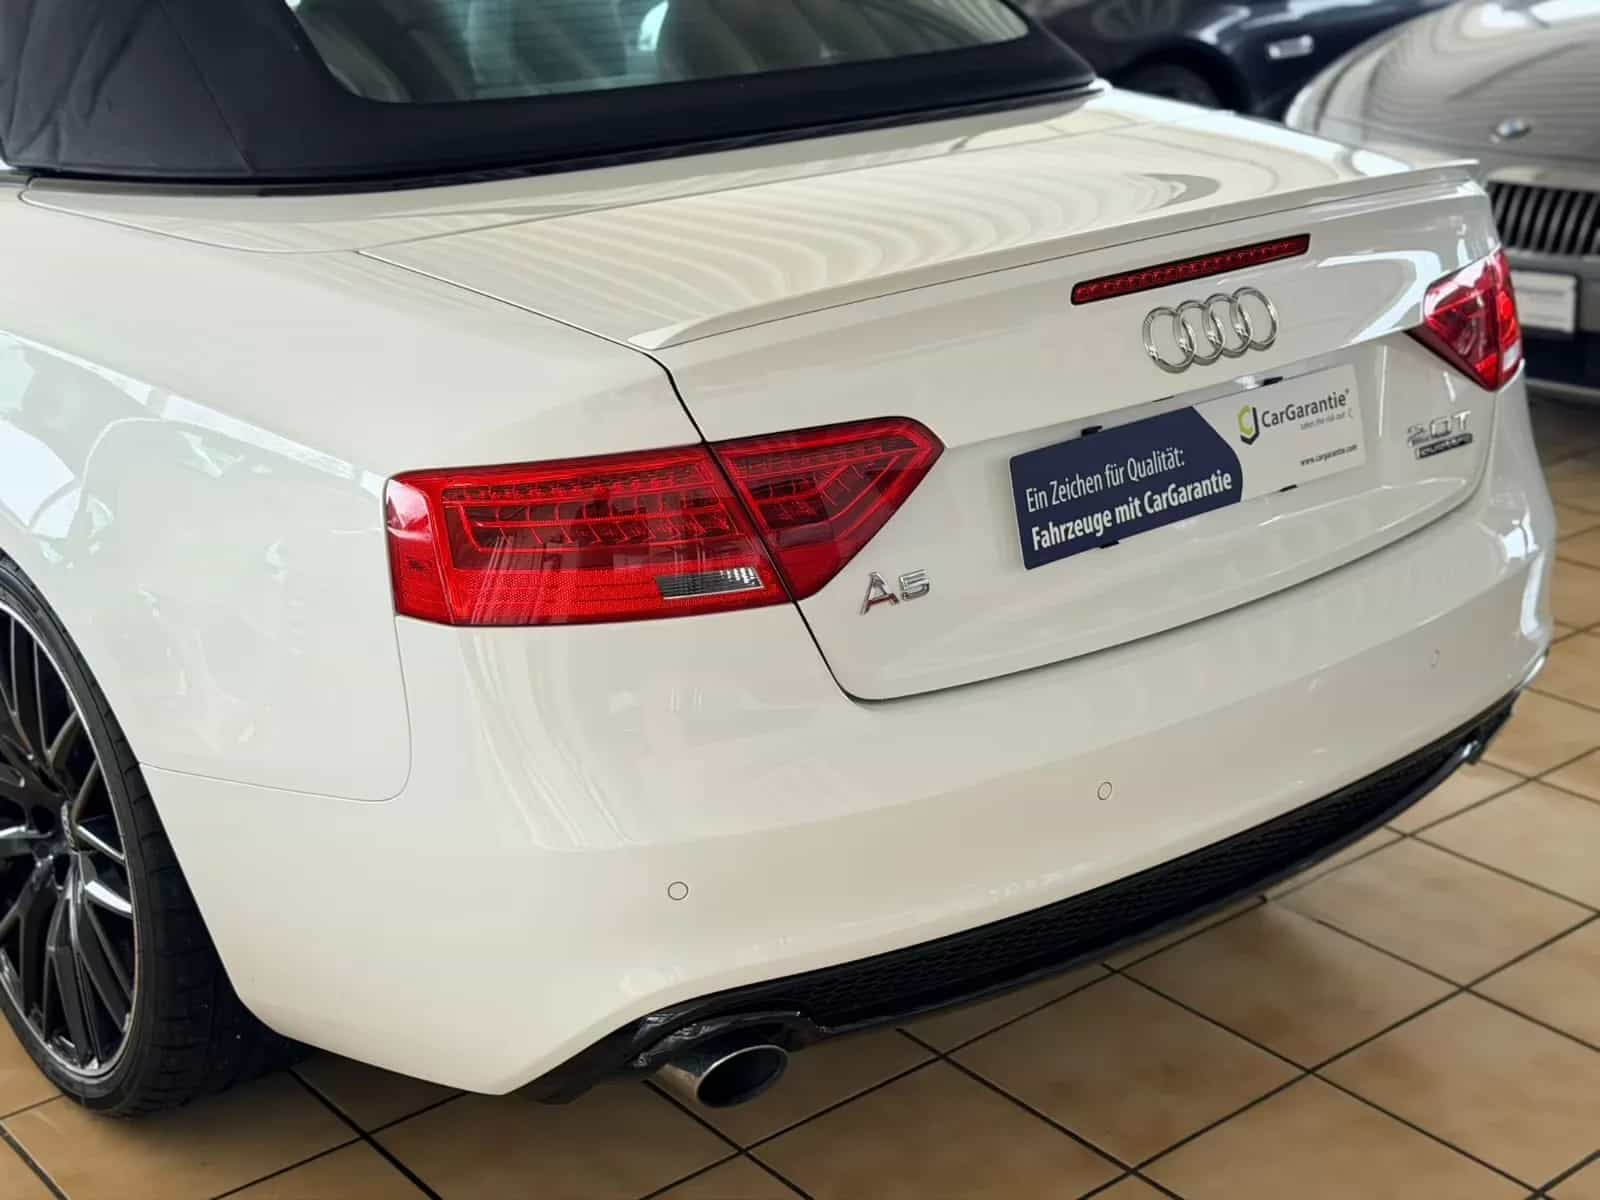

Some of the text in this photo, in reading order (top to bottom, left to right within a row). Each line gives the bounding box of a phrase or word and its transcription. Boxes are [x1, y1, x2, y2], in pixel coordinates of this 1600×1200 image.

[1261, 391, 1347, 428] CarGarantie
[1025, 446, 1185, 513] Ein Zeichen für Qualität:
[1031, 469, 1233, 551] Fahrzeuge mit CarGarantie
[859, 567, 930, 617] A5
